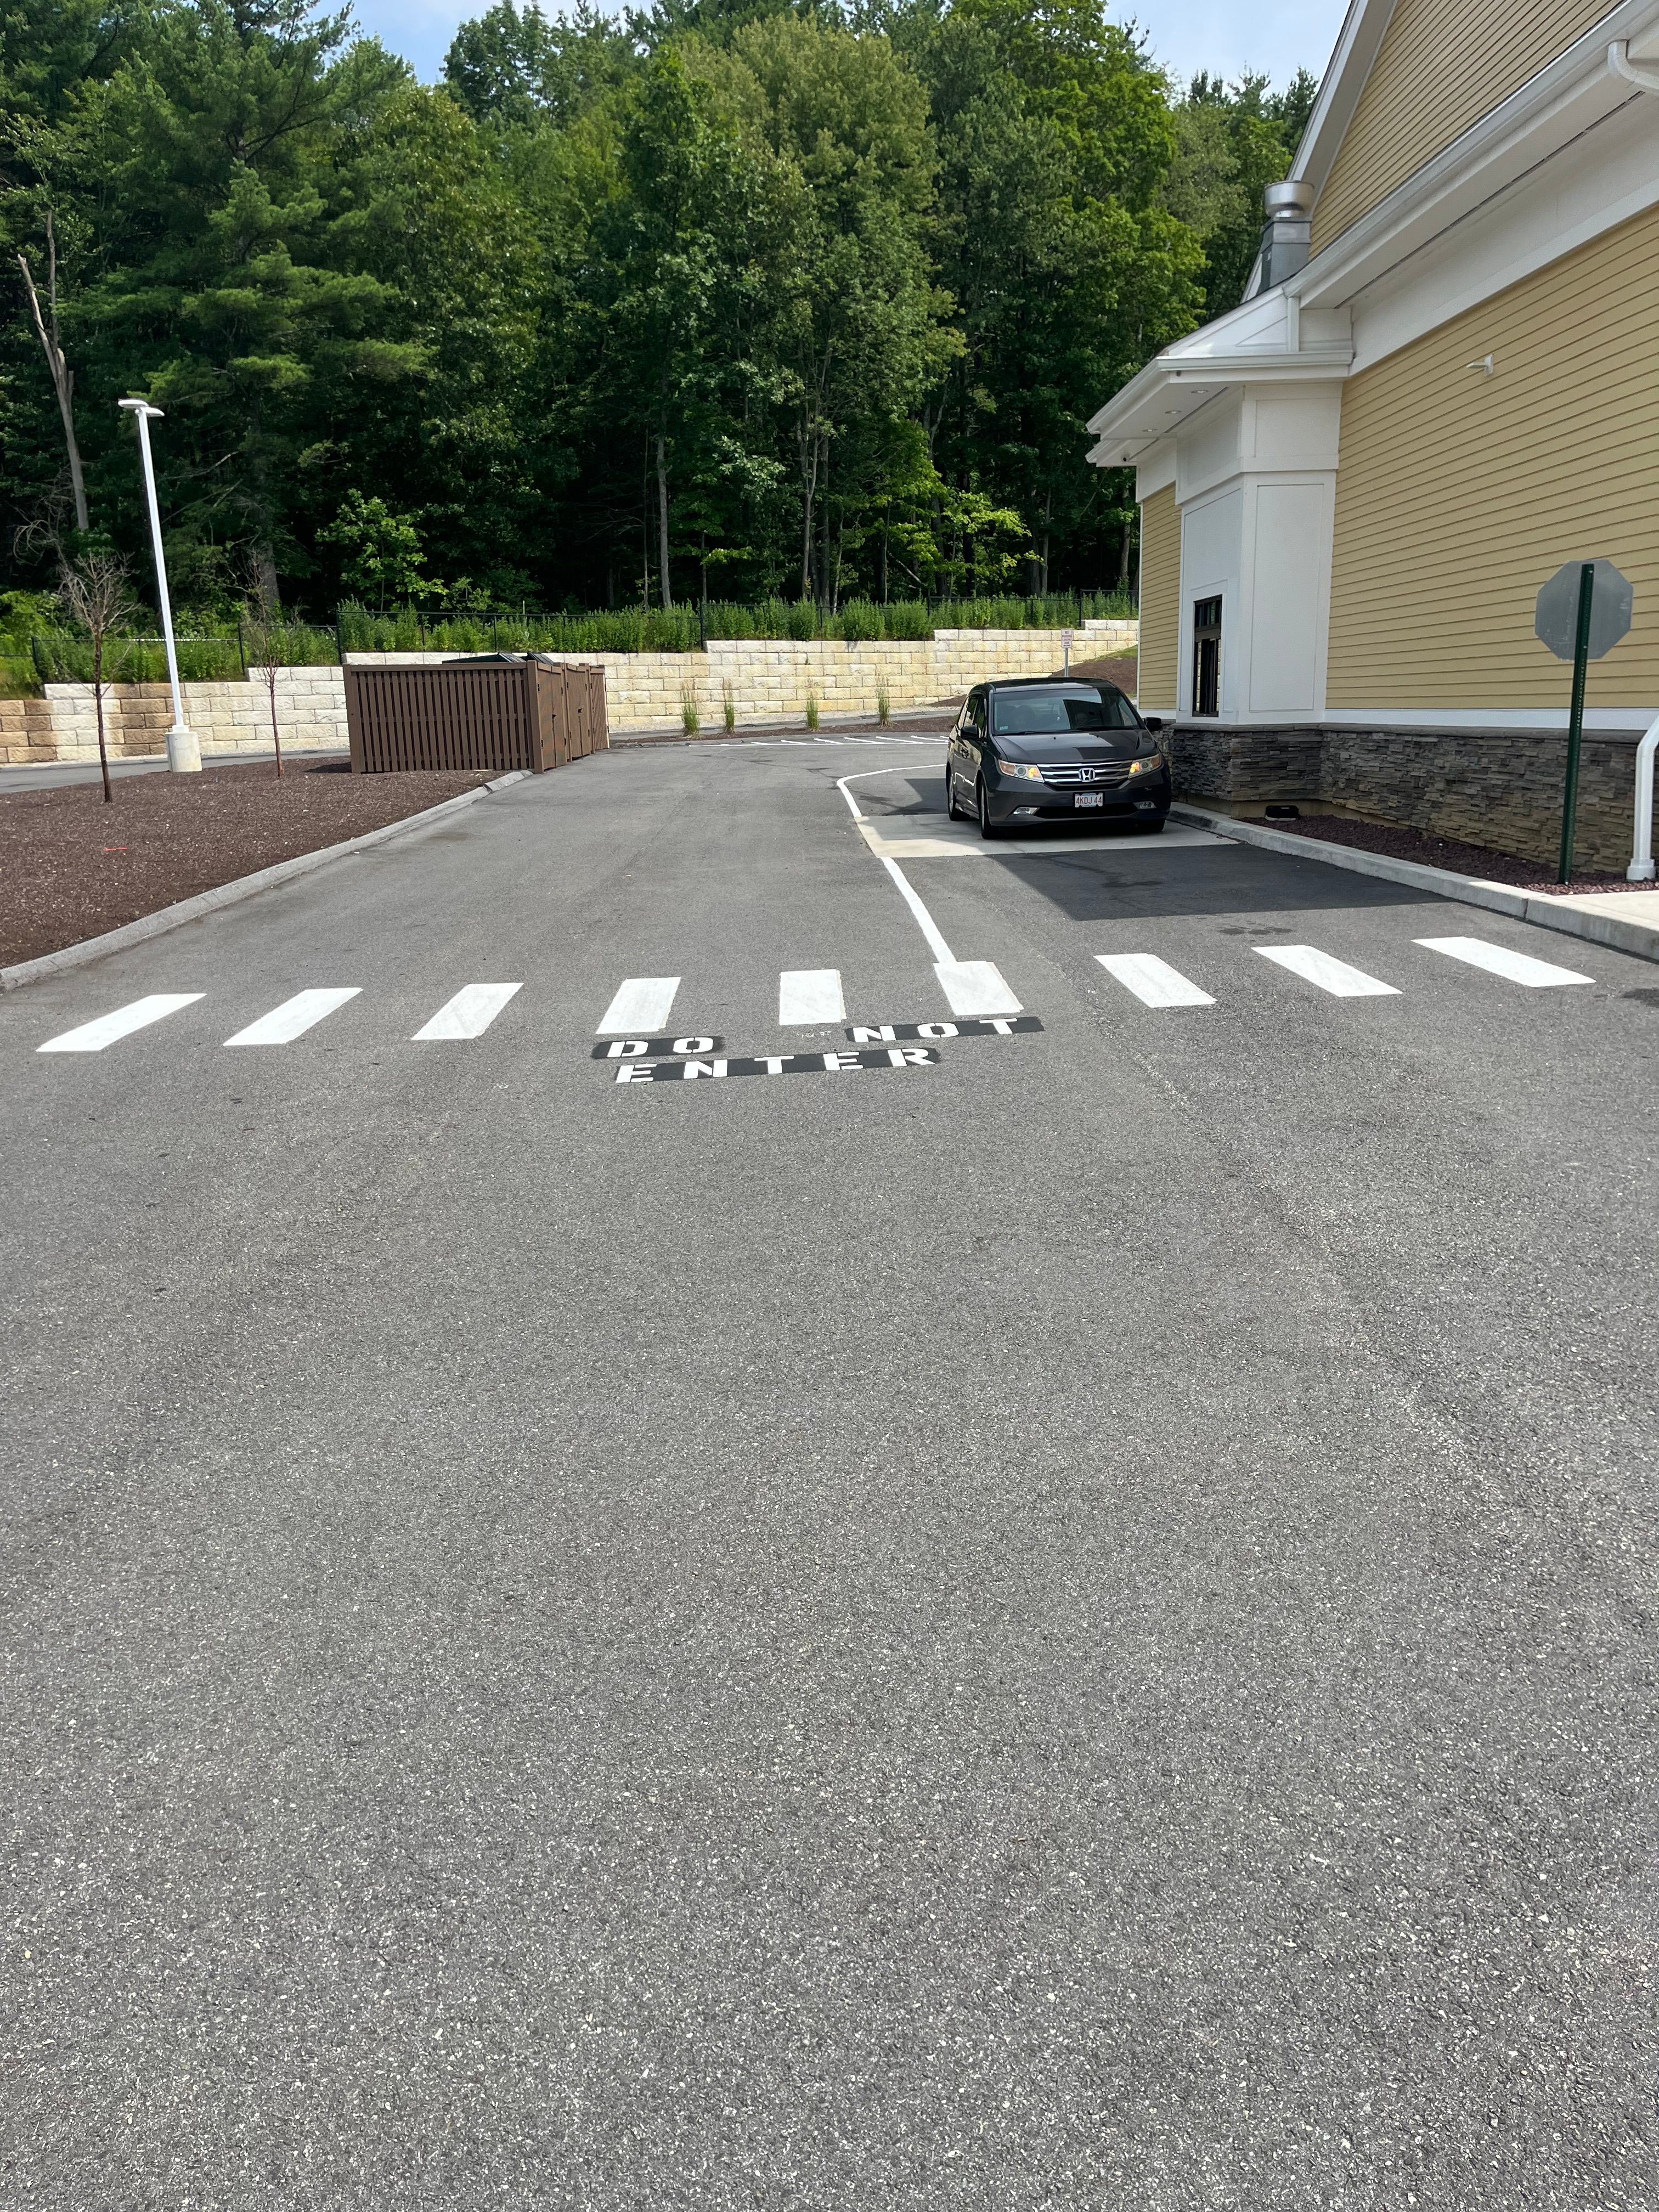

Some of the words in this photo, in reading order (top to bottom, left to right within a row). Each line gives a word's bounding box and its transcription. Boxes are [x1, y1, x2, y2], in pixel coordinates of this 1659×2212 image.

[607, 1037, 714, 1058] DO
[853, 1018, 1018, 1042] NOT
[616, 1048, 935, 1083] ENTER
